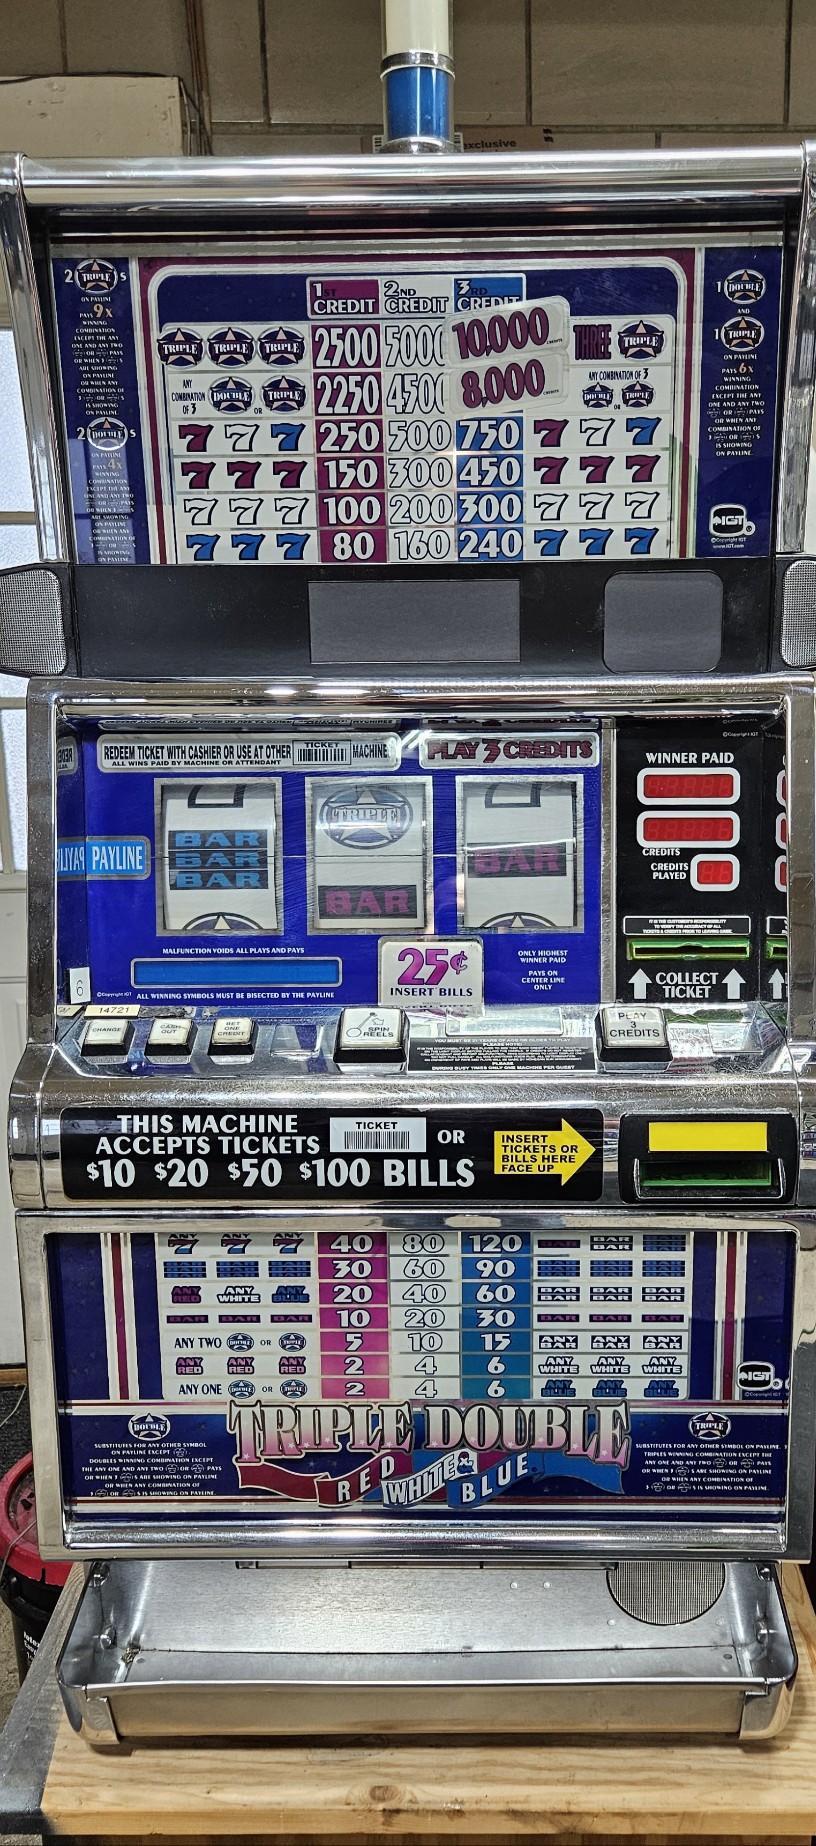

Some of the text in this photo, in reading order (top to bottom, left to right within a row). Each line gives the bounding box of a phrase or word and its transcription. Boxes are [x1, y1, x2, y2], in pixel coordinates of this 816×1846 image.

[82, 273, 111, 282] TRIPLE
[728, 282, 761, 292] DOUBLE
[312, 280, 488, 298] 1ST 2ND 3RD
[314, 297, 519, 315] CREDIT CREDIT CREDIT
[737, 307, 750, 315] AND
[452, 306, 549, 359] 10,000
[728, 329, 757, 338] TRIPLE
[162, 326, 379, 367] TRIPLE TRIPLE TRIPLE 2500
[573, 324, 658, 361] THREE TRIPLE
[461, 359, 545, 409] 8,000
[588, 368, 648, 381] ANY COMBINATION OF 3
[213, 390, 301, 402] DOUBLE TRIPLE
[317, 375, 379, 415] 2250
[319, 421, 382, 452] 250
[389, 420, 452, 451] 500
[461, 420, 521, 450] 750
[324, 459, 378, 489] 150
[389, 457, 452, 488] 300
[460, 457, 522, 486] 450
[324, 496, 382, 525] 100
[389, 494, 452, 524] 200
[461, 494, 522, 523] 300
[722, 515, 745, 525] IGT
[333, 531, 375, 560] 80
[395, 530, 450, 560] 160
[460, 530, 522, 559] 240
[104, 744, 291, 760] REDEEM TICKET WITH CASHIER OR USE AT OTHER
[353, 744, 388, 759] MACHINE
[427, 738, 594, 764] PLAY 3 CREDITS
[646, 753, 734, 764] WINNER PAID
[334, 807, 397, 823] TRIPLE
[175, 833, 261, 847] BAR
[92, 846, 143, 870] PAYLINE
[174, 853, 261, 867] BAR
[474, 847, 560, 873] BAR
[642, 848, 681, 856] CREDITS
[650, 863, 689, 871] CREDITS
[652, 872, 687, 880] PLAYED
[175, 873, 261, 887] BAR
[324, 890, 409, 915] BAR
[398, 948, 467, 986] 25¢
[656, 973, 719, 984] COLLECT
[390, 987, 473, 997] INSERT BILLS
[663, 986, 712, 998] TICKET
[618, 1012, 647, 1020] PLAY
[630, 1021, 637, 1029] 3
[610, 1029, 660, 1038] CREDITS
[117, 1115, 298, 1134] THIS MACHINE
[356, 1122, 398, 1130] TICKET
[96, 1136, 320, 1155] ACCEPTS TICKETS
[438, 1130, 465, 1143] OR
[501, 1135, 548, 1143] INSERT
[501, 1145, 578, 1153] TICKETS OR
[502, 1155, 576, 1163] BILLS HERE
[87, 1158, 475, 1188] $10 $20 $50 $100 BILLS
[502, 1165, 554, 1173] FACE UP
[331, 1235, 373, 1253] 40
[402, 1233, 444, 1253] 80
[468, 1234, 522, 1253] 120
[333, 1259, 373, 1279] 30
[403, 1258, 443, 1279] 60
[476, 1259, 516, 1278] 90
[333, 1284, 374, 1304] 20
[402, 1283, 446, 1304] 40
[476, 1284, 516, 1304] 60
[336, 1309, 371, 1329] 10
[404, 1309, 445, 1329] 20
[476, 1309, 516, 1328] 30
[346, 1334, 363, 1351] 5
[407, 1333, 443, 1352] 10
[480, 1333, 511, 1352] 15
[134, 1424, 166, 1432] DOUBLE
[228, 1400, 632, 1470] TRIPLE DOUBLE
[695, 1422, 723, 1430] TRIPLE
[338, 1452, 530, 1506] RED WHITE & BLUE
